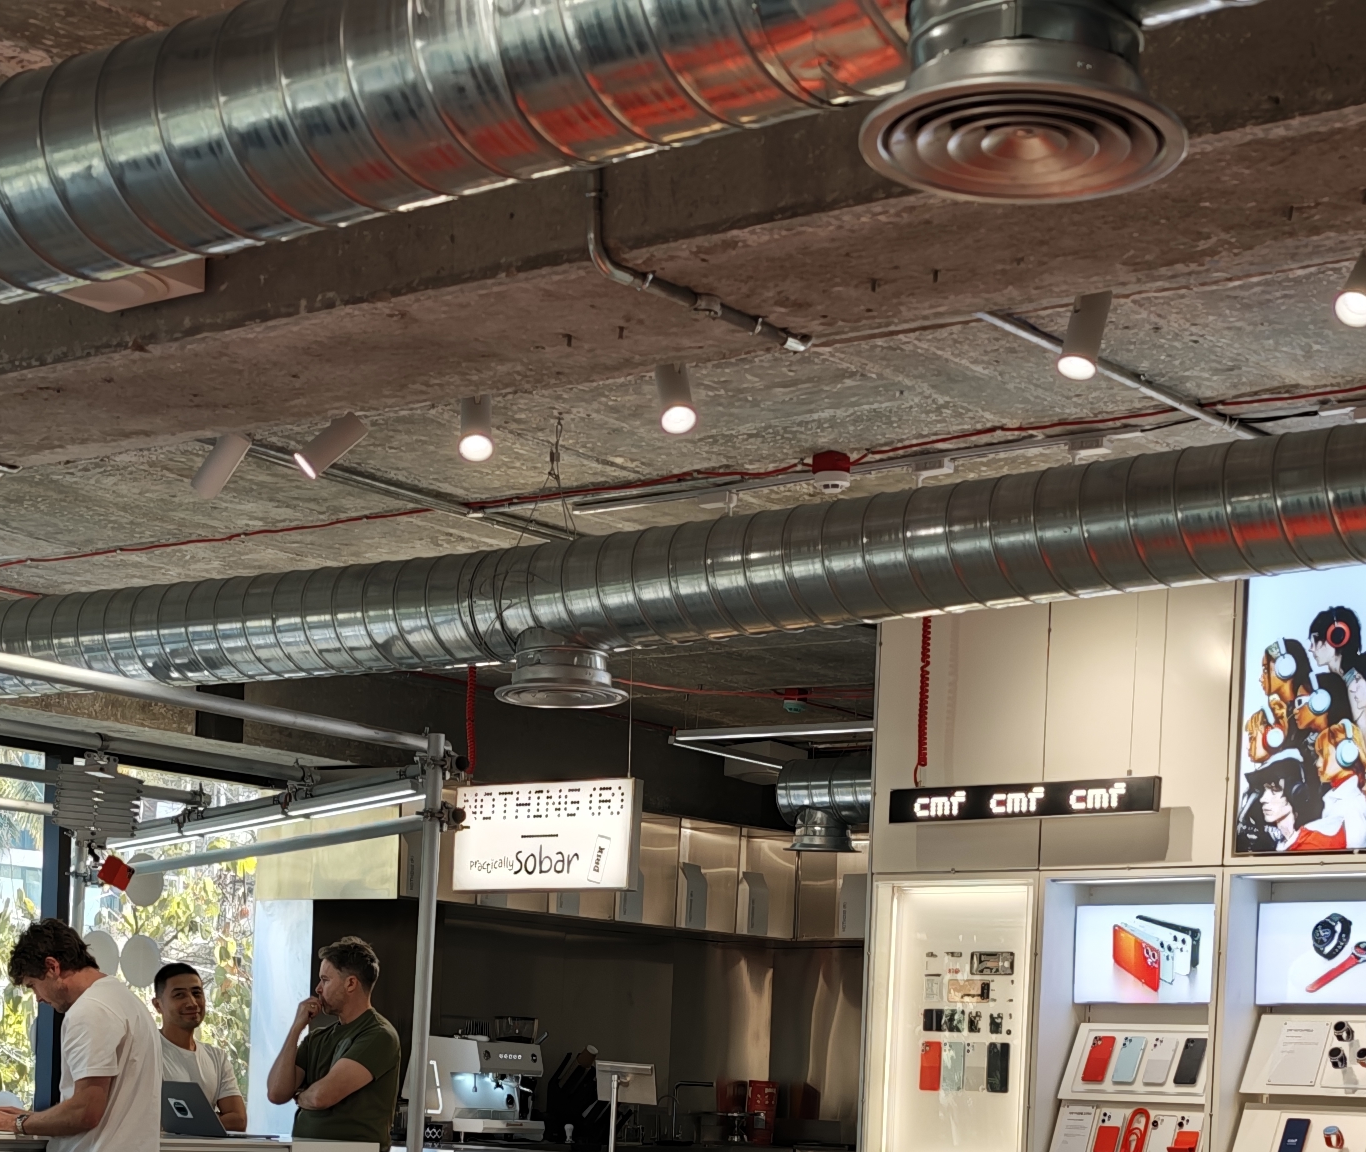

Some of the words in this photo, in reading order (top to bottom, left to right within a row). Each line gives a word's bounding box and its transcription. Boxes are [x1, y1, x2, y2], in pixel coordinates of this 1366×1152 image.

[463, 788, 581, 820] NOTHING
[588, 785, 625, 816] (R)
[914, 790, 966, 817] cmf
[990, 787, 1044, 813] cmf
[1070, 782, 1126, 809] cmf
[469, 855, 514, 874] practically
